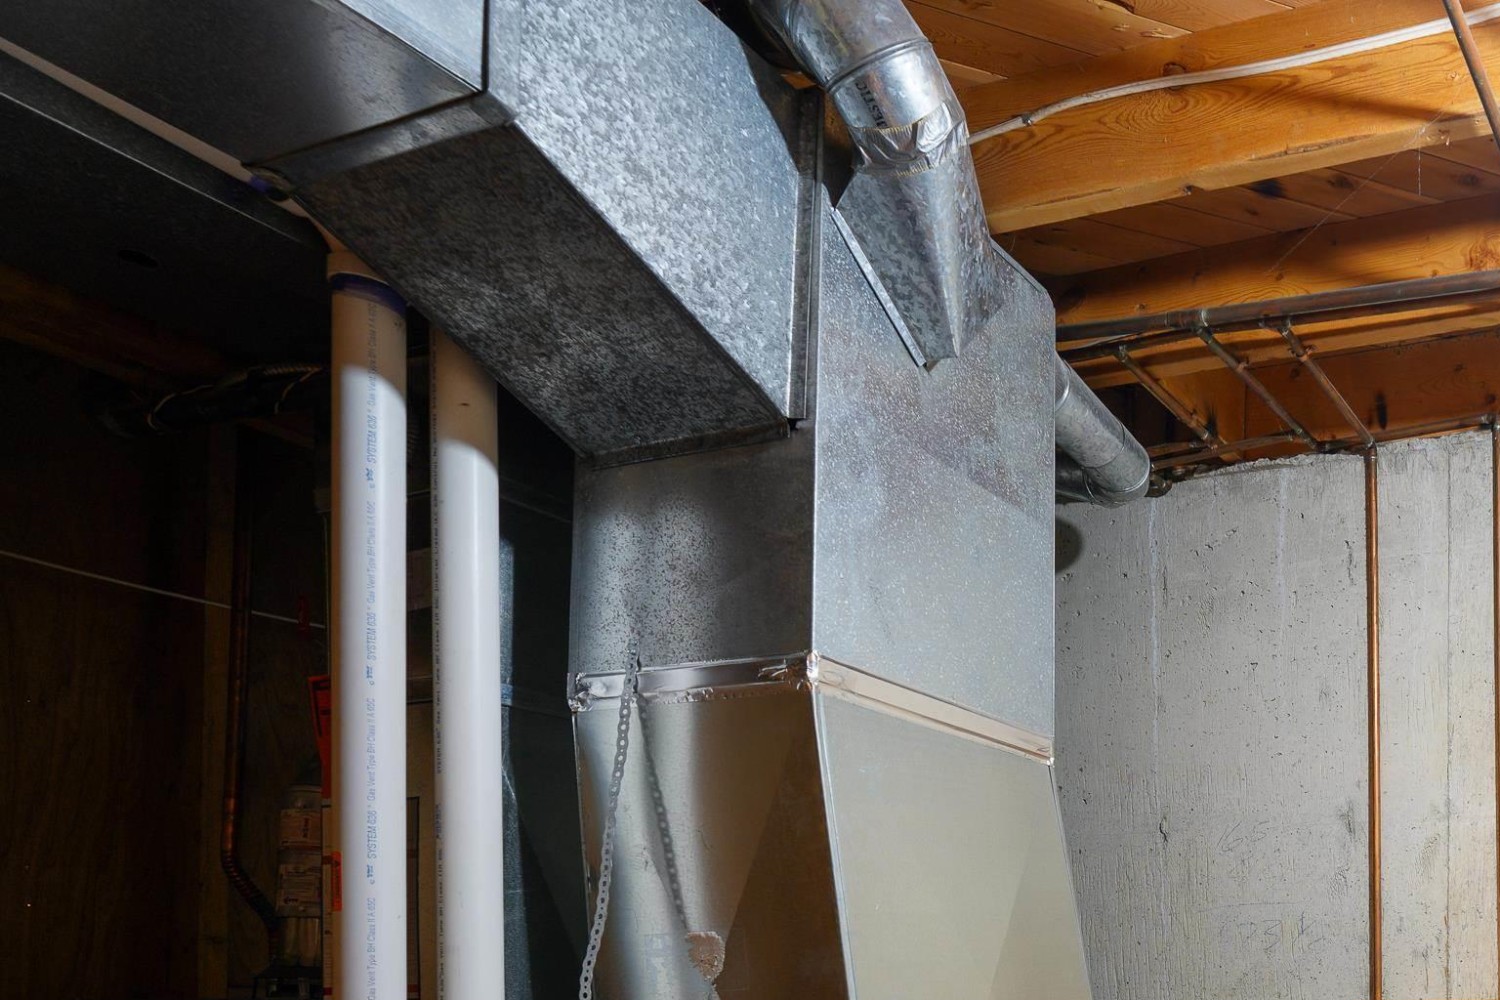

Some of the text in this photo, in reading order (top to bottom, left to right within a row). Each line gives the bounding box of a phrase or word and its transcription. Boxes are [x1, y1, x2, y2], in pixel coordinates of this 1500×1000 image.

[366, 628, 376, 661] SYSTEM
[366, 772, 376, 786] Vent
[366, 787, 376, 801] Gas
[366, 810, 377, 825] 636
[366, 826, 377, 859] SYSTEM
[366, 971, 375, 985] Vent
[366, 986, 375, 1000] Gas
